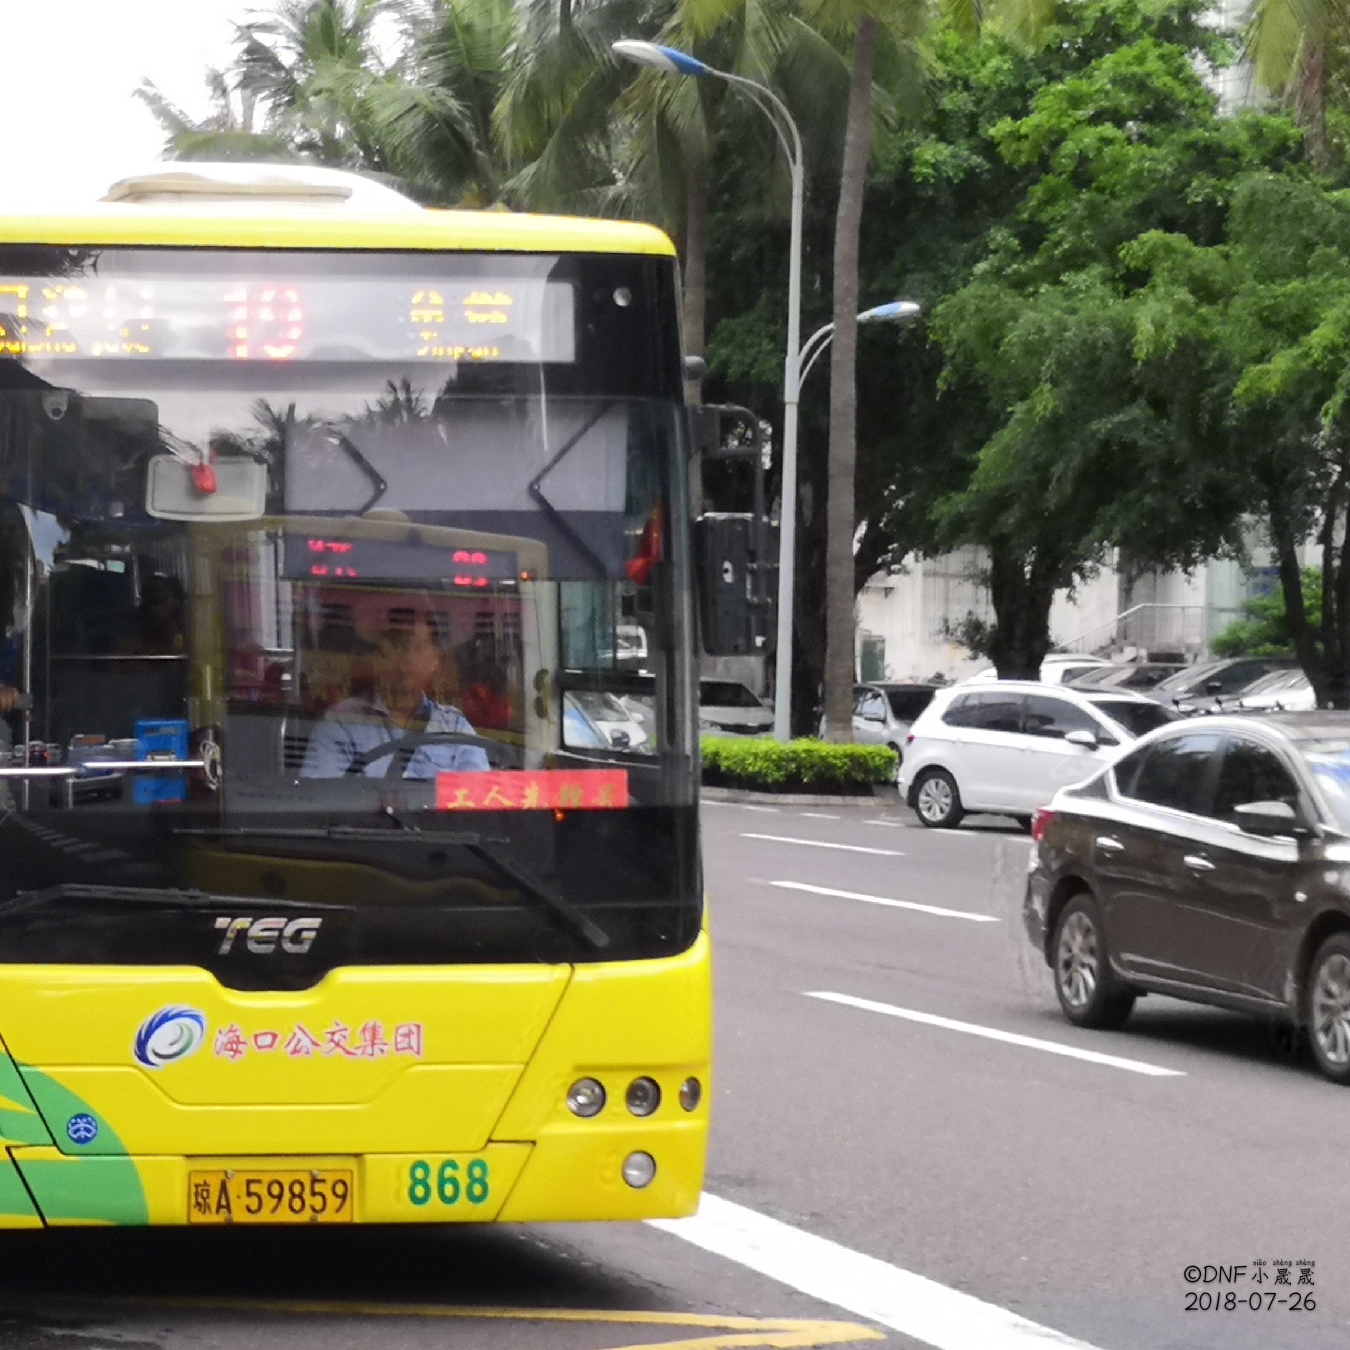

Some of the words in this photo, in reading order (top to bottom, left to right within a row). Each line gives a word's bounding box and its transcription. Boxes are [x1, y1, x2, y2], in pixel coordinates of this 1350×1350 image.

[213, 917, 322, 954] TEG
[214, 1022, 423, 1059] 海口公交集团
[408, 1159, 489, 1206] 868
